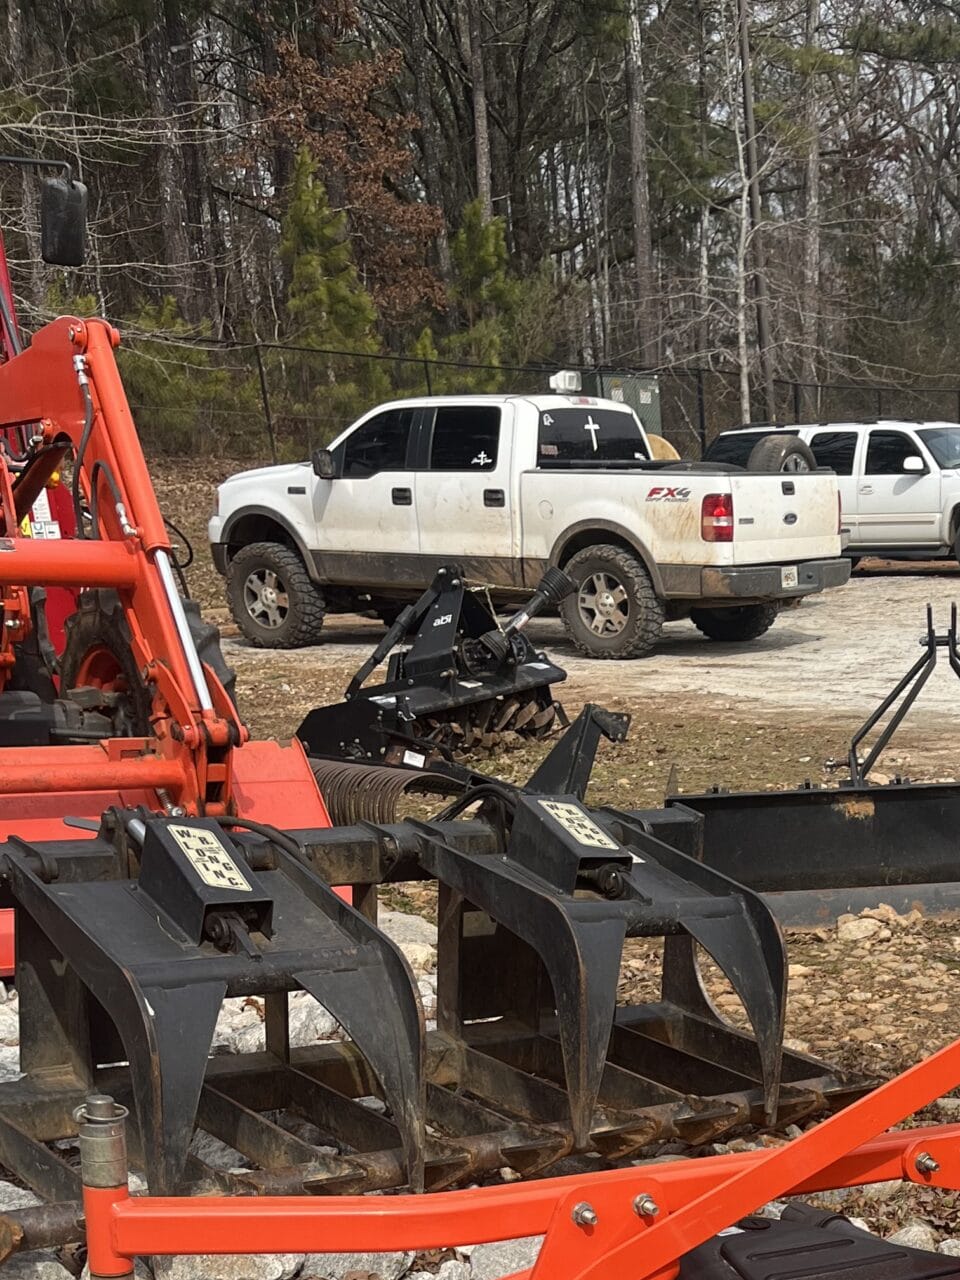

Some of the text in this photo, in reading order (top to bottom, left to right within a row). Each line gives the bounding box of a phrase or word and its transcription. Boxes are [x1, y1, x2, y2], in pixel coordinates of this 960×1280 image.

[647, 487, 691, 498] FX4
[433, 614, 452, 627] abi
[554, 812, 600, 835] LONG
[183, 841, 233, 871] LONG
[202, 862, 243, 886] INC.
